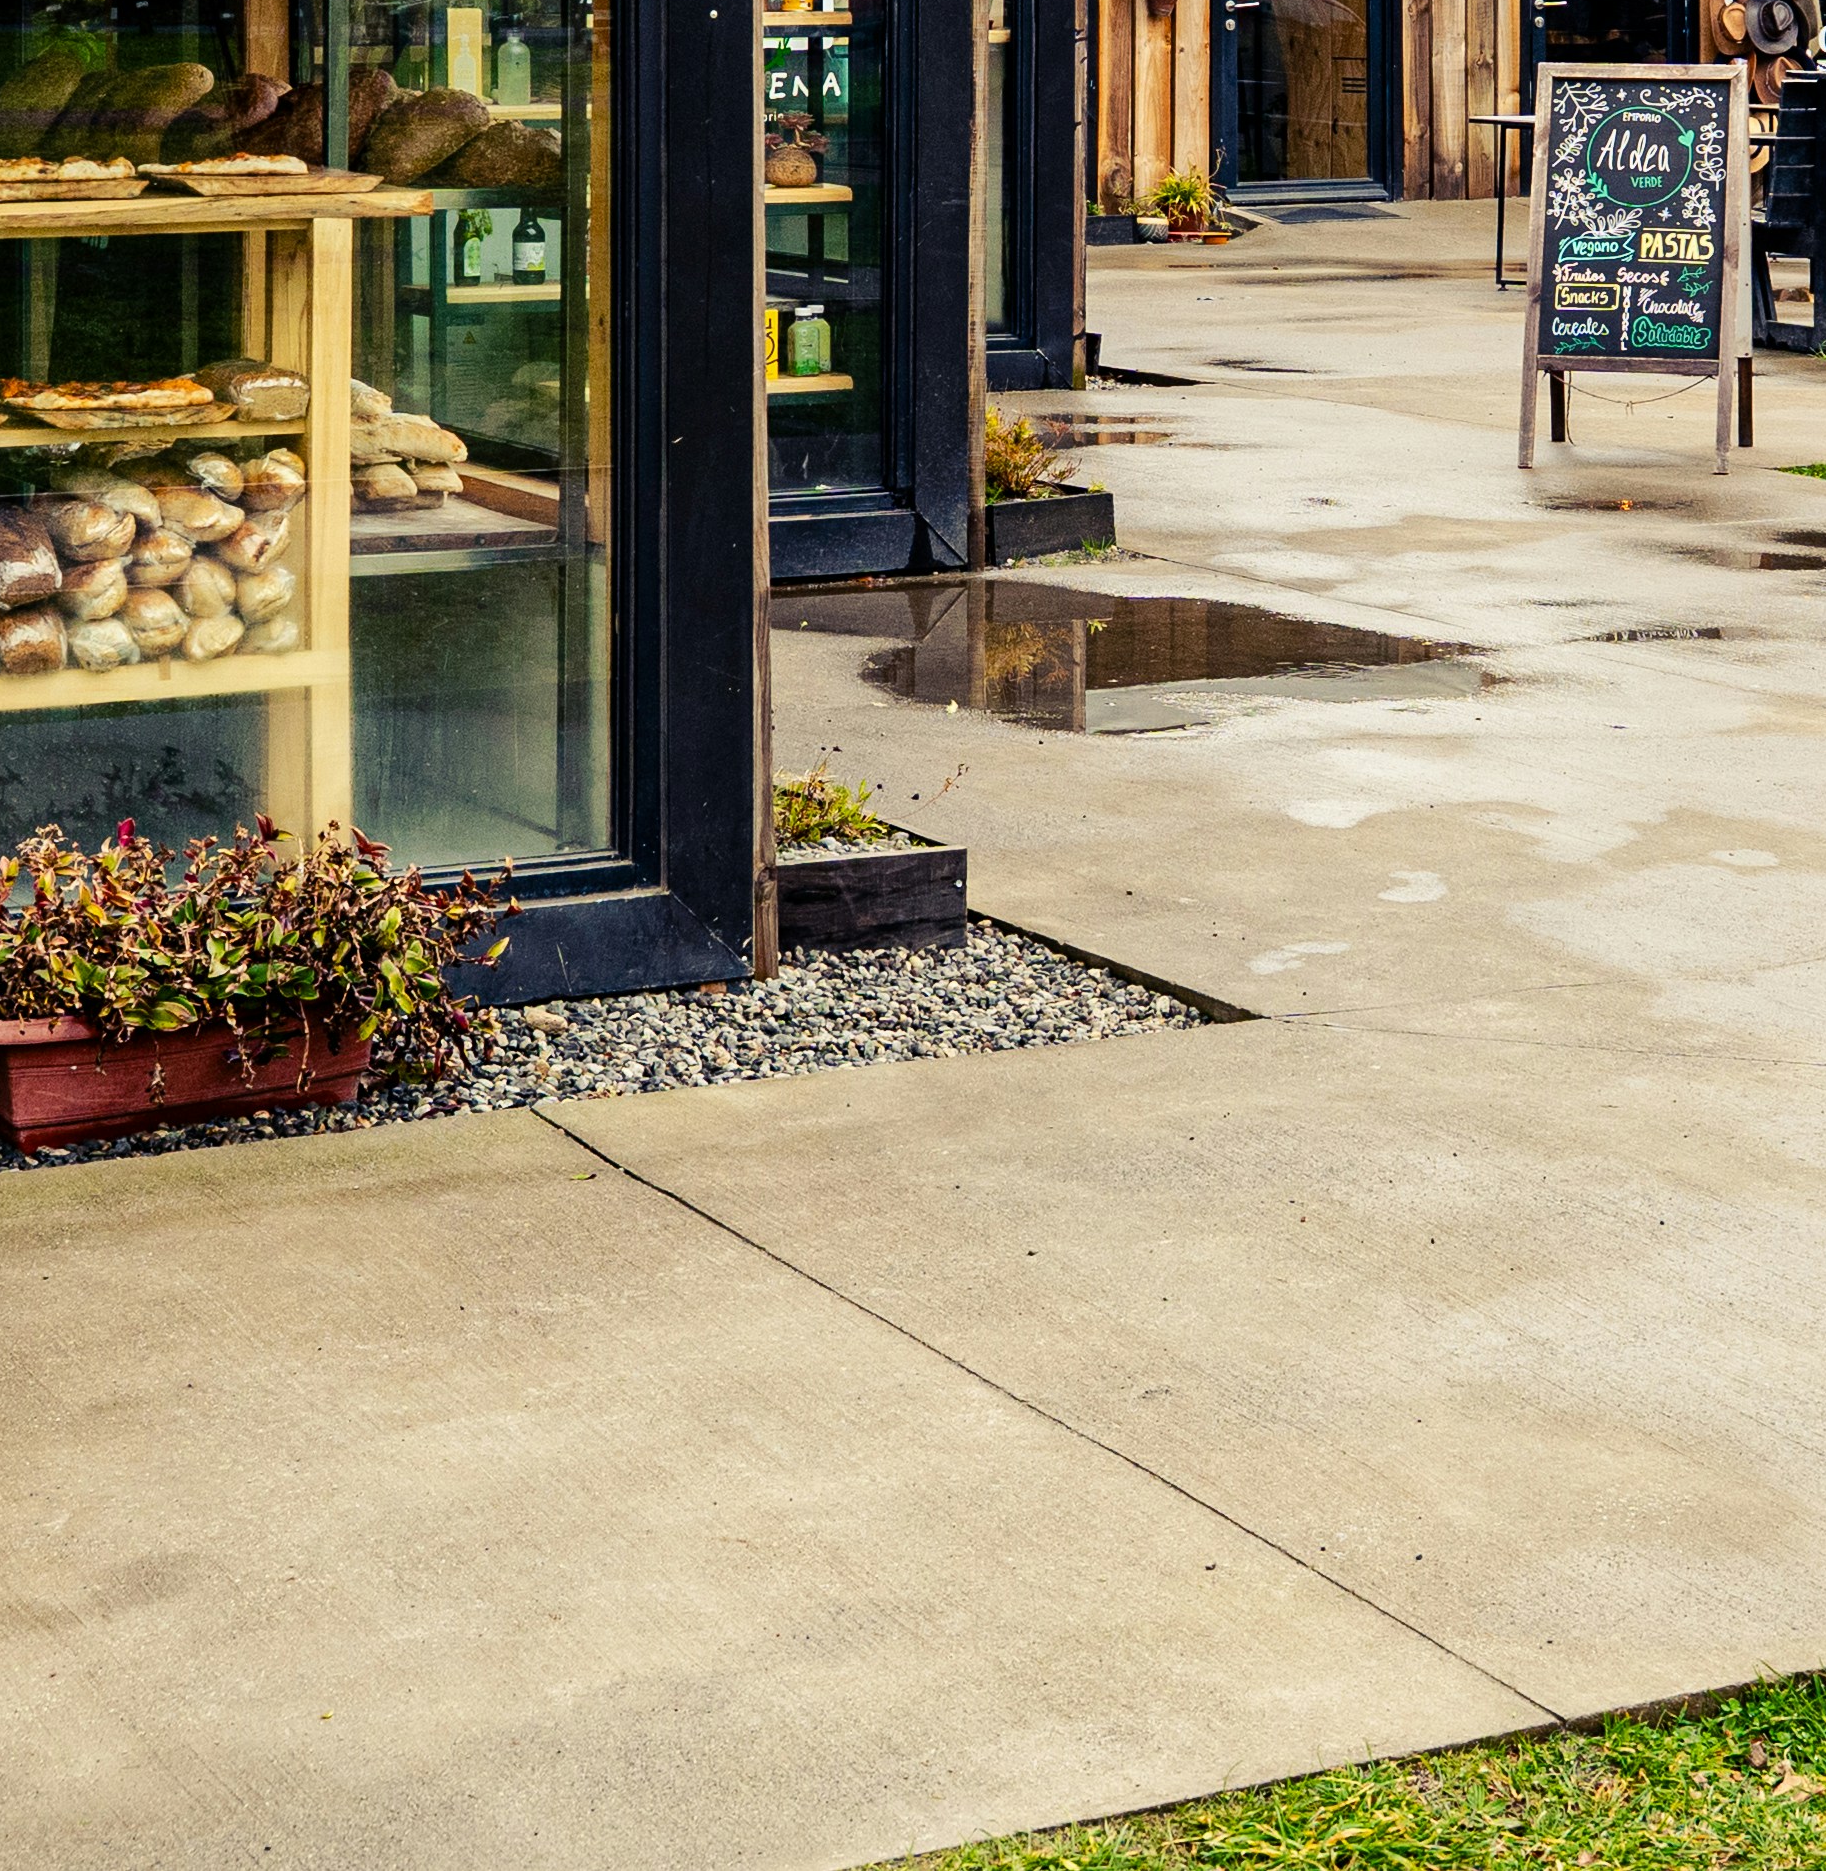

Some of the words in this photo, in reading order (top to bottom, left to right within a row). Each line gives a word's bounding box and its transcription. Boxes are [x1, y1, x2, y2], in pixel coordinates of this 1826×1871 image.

[1622, 111, 1662, 124] EMPORIO
[1596, 128, 1671, 173] Aldea
[1630, 176, 1663, 188] VERDE
[1640, 232, 1715, 260] PASTAS
[1562, 262, 1606, 282] Frutos
[1616, 267, 1660, 283] Secos
[1561, 287, 1609, 305] Snacks
[1642, 298, 1701, 315] Chocolate
[1551, 317, 1610, 336] Cereales
[1637, 320, 1702, 345] Saludable
